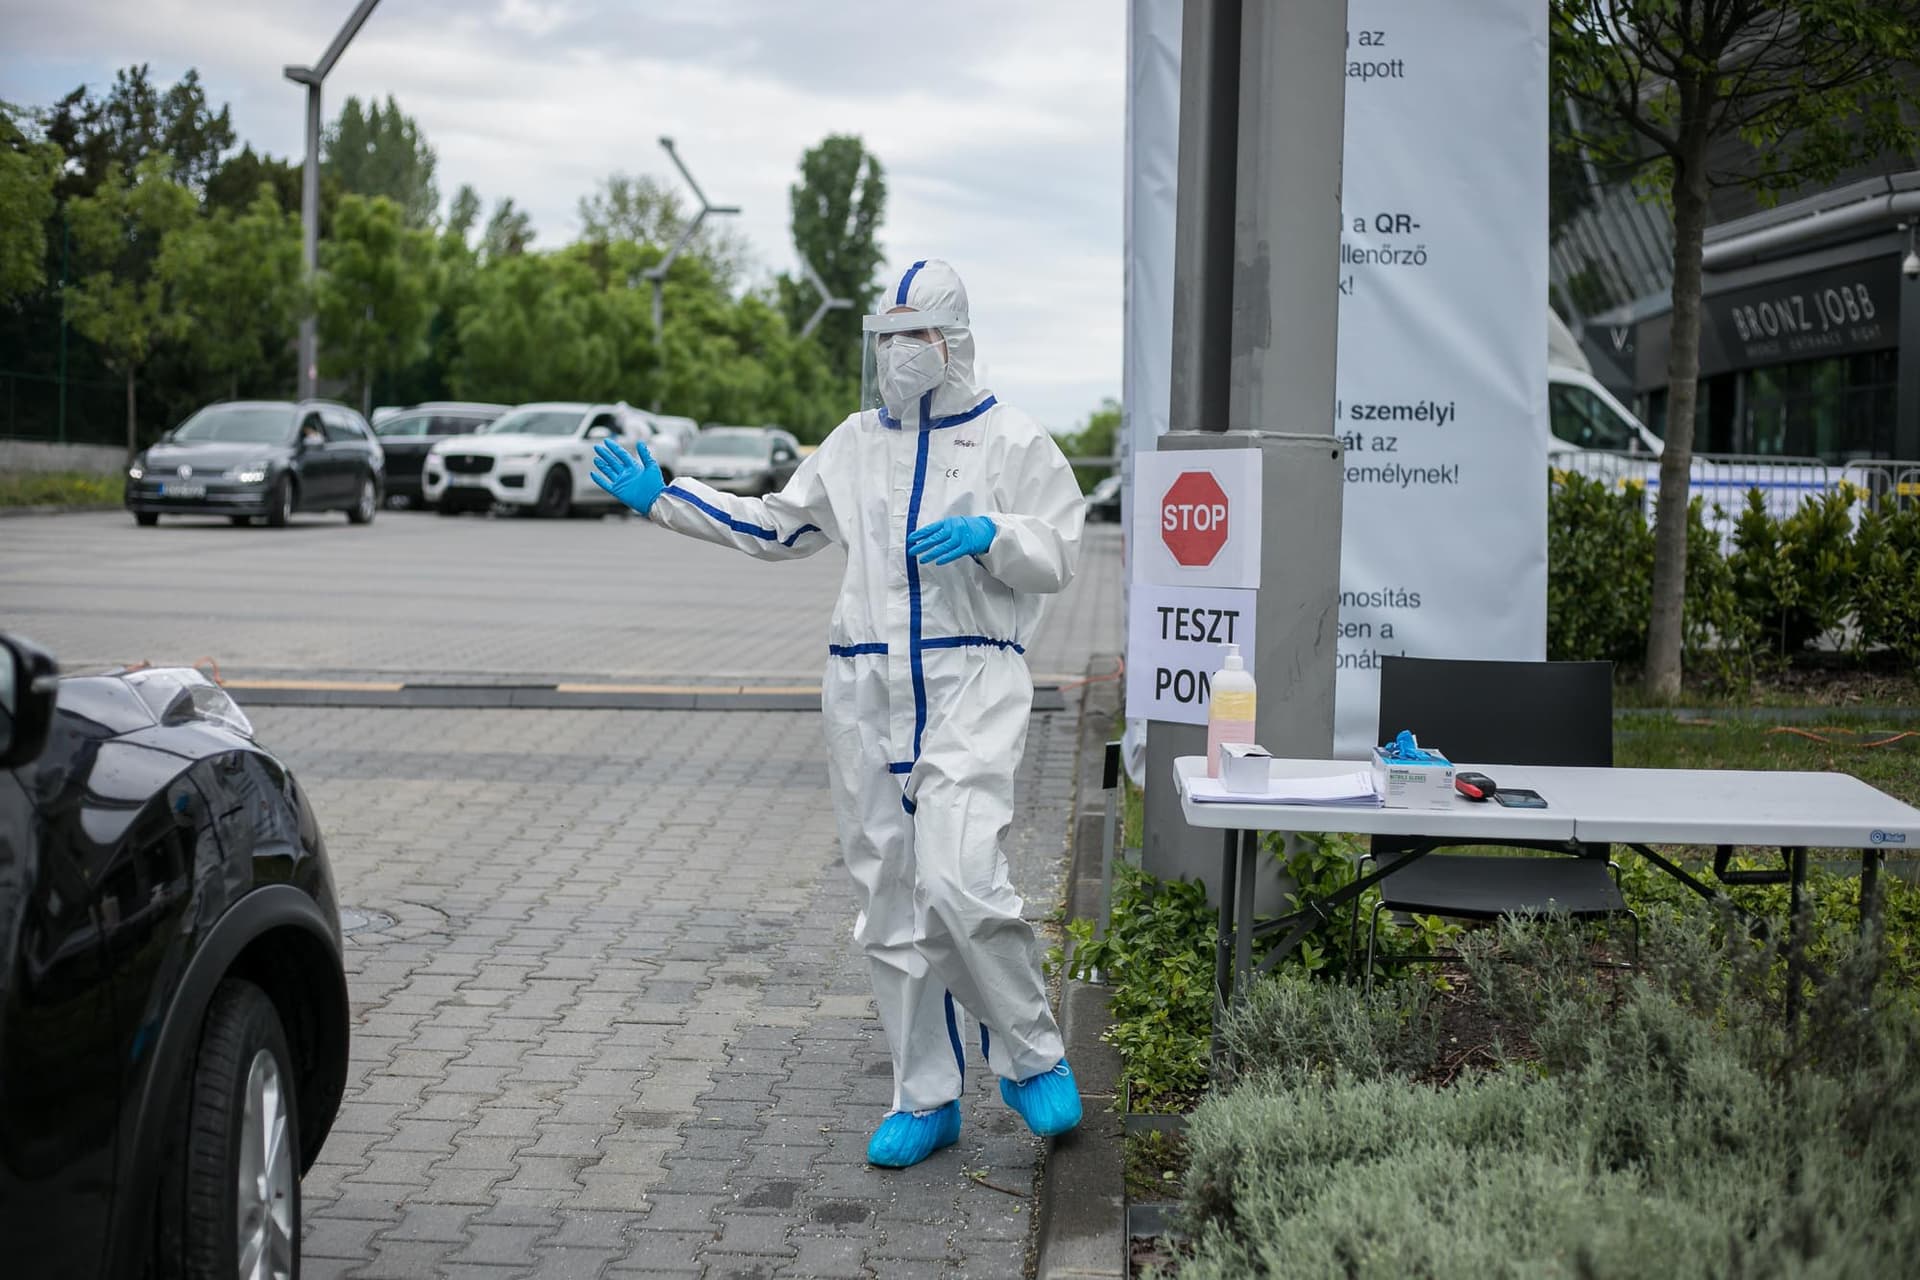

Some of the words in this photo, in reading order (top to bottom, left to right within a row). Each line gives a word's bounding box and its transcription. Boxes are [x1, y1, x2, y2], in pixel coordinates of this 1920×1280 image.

[1358, 30, 1385, 46] az
[1345, 59, 1404, 82] apott
[1353, 217, 1366, 233] a
[1375, 213, 1421, 233] QR-
[1731, 296, 1812, 341] BRONZ
[1814, 283, 1876, 331] JOBB
[1351, 400, 1455, 427] személyi
[1371, 436, 1398, 452] az
[1344, 463, 1458, 488] emélynek!
[1163, 504, 1226, 531] STOP
[1157, 606, 1240, 644] TESZT
[1380, 622, 1393, 639] a
[1155, 668, 1217, 705] PON
